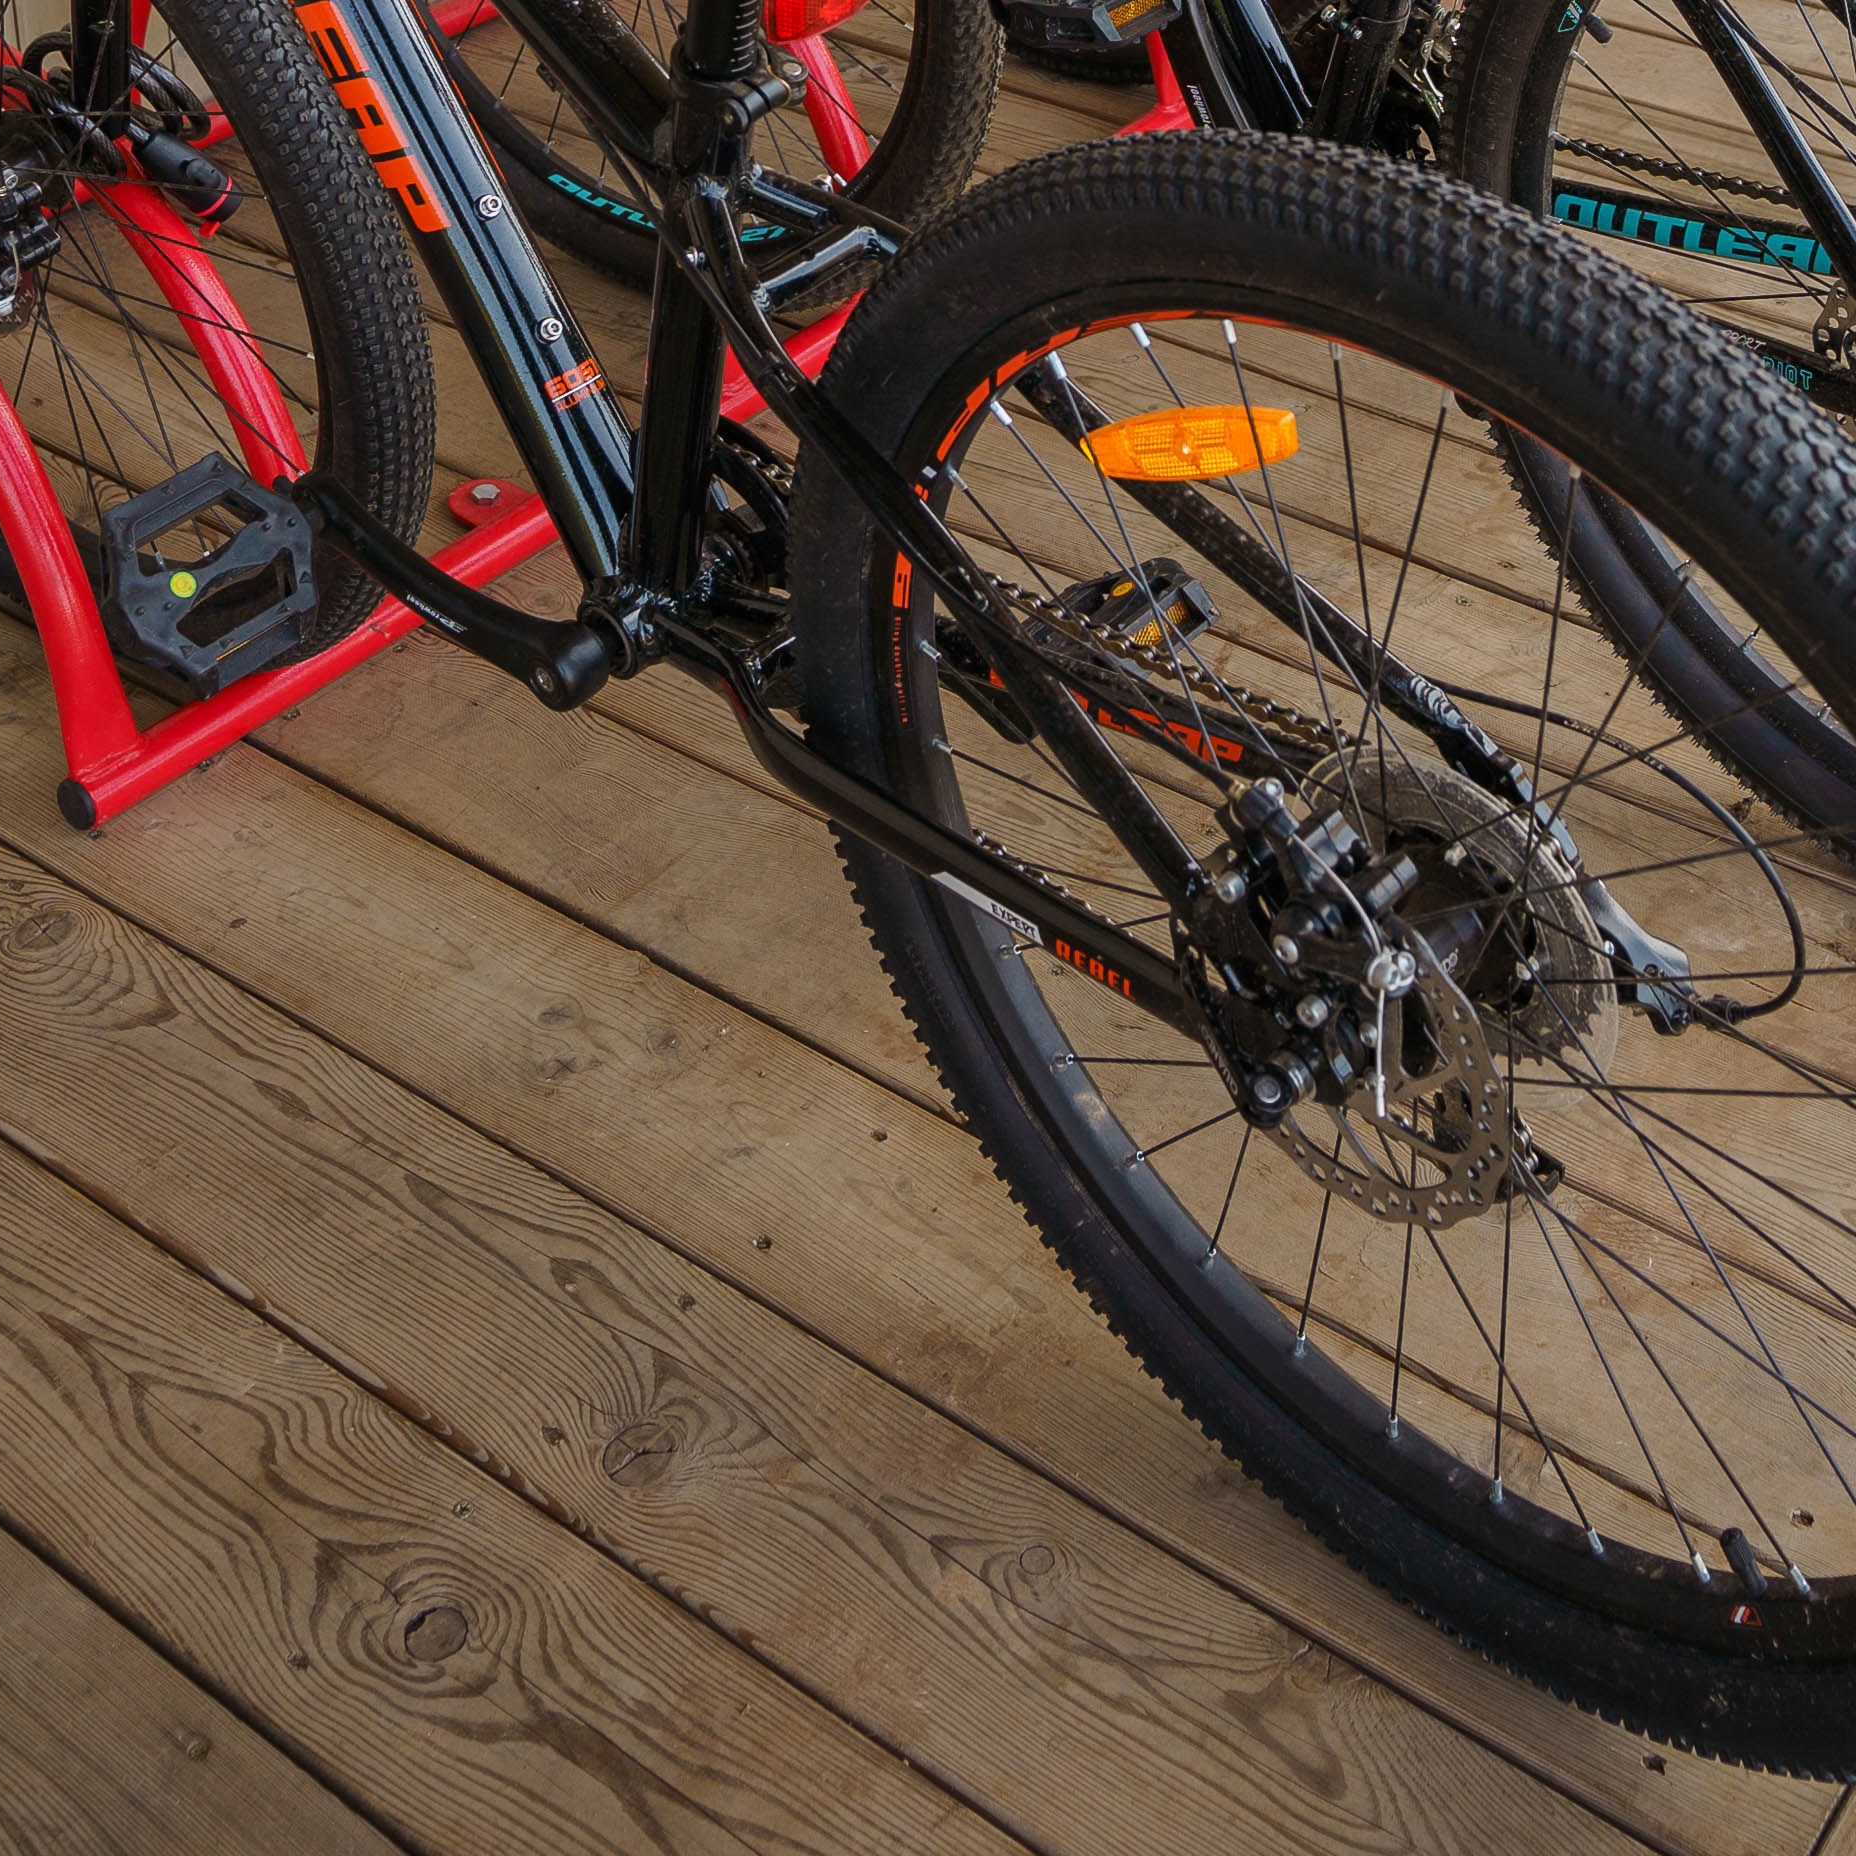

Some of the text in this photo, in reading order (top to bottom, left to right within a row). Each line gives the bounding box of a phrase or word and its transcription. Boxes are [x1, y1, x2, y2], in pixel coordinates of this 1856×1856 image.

[1186, 84, 1211, 124] rowheel
[545, 357, 600, 400] 6061
[990, 902, 1037, 938] EXPERT
[1056, 938, 1136, 1001] REBEL
